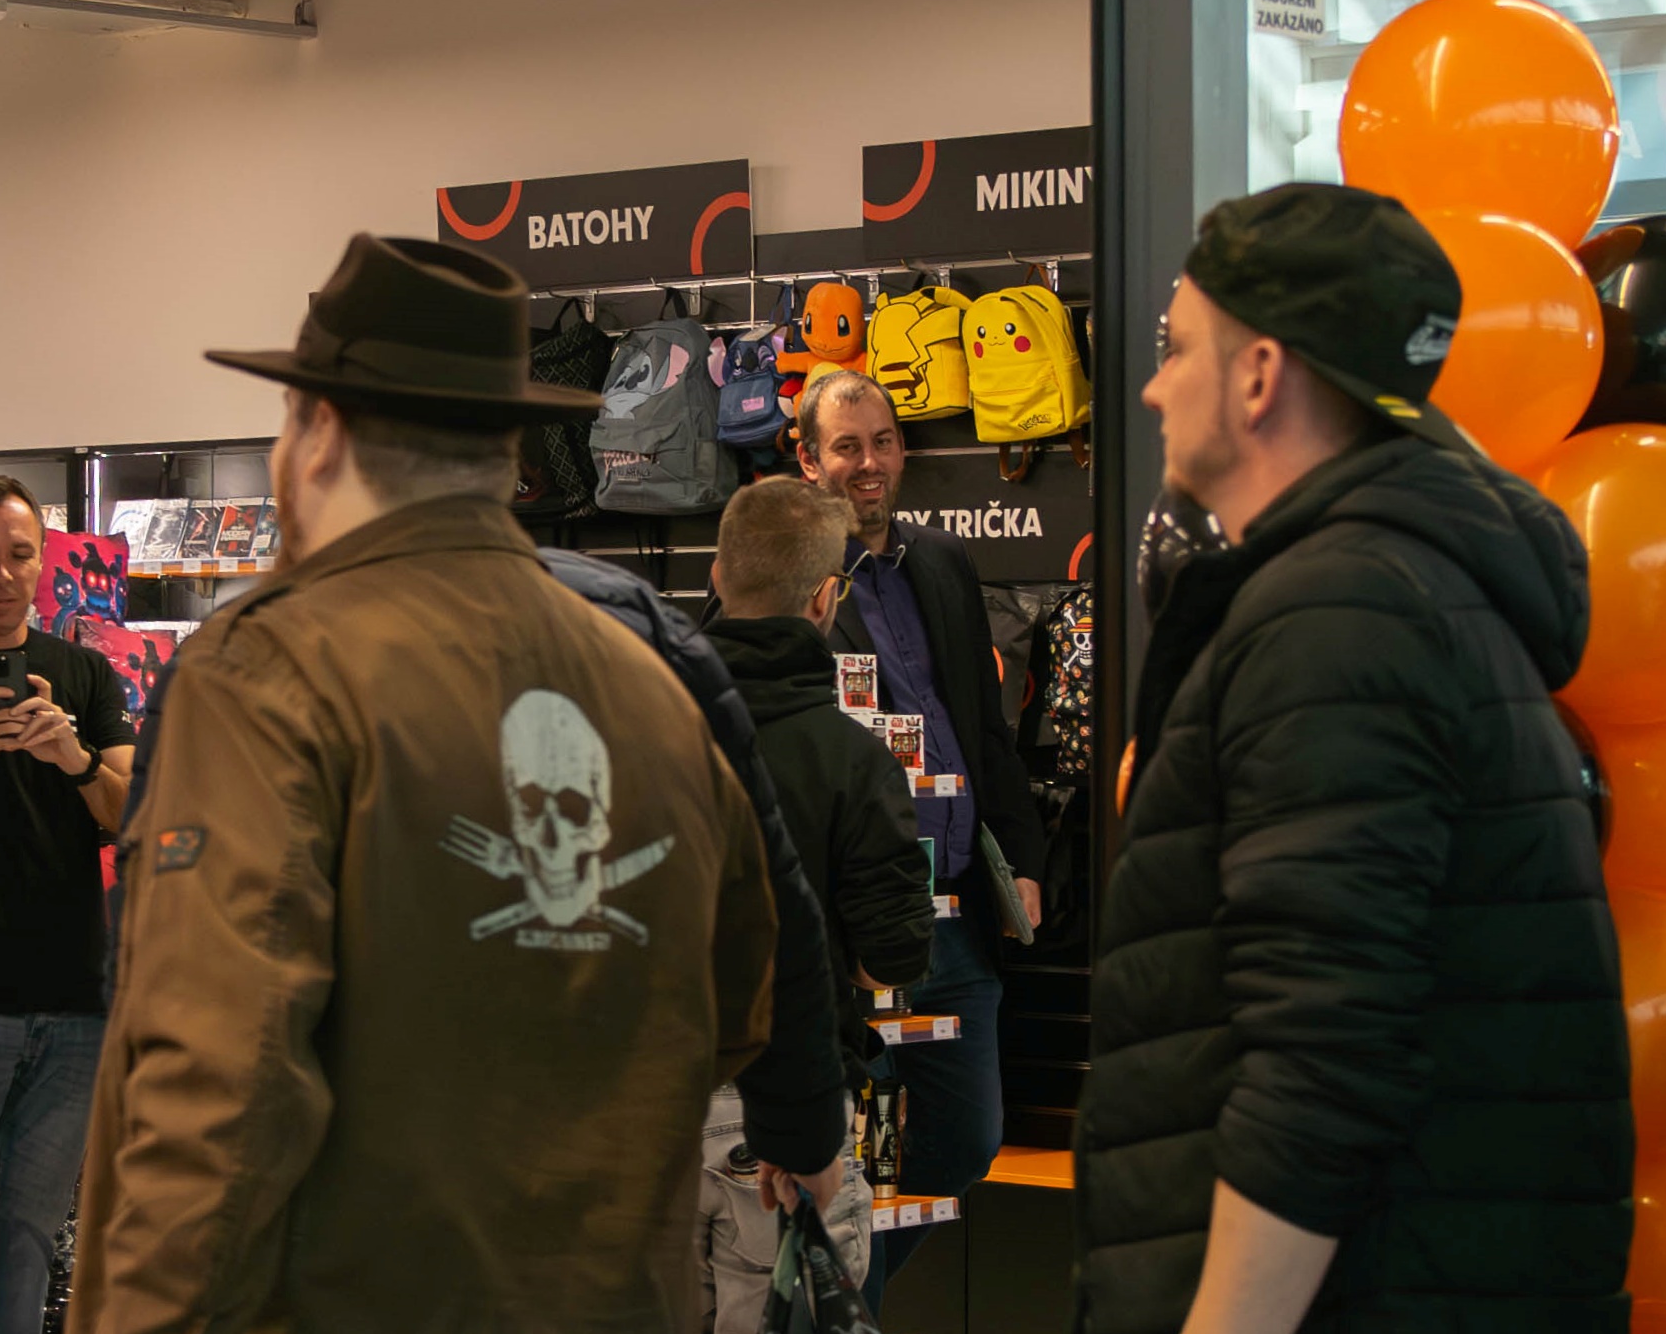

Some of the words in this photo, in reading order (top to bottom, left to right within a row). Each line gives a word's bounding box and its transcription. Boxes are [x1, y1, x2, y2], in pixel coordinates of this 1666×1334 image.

[1257, 10, 1325, 36] ZAKÁZÁNO
[528, 205, 655, 250] BATOHY
[939, 500, 1044, 539] TRIČKA
